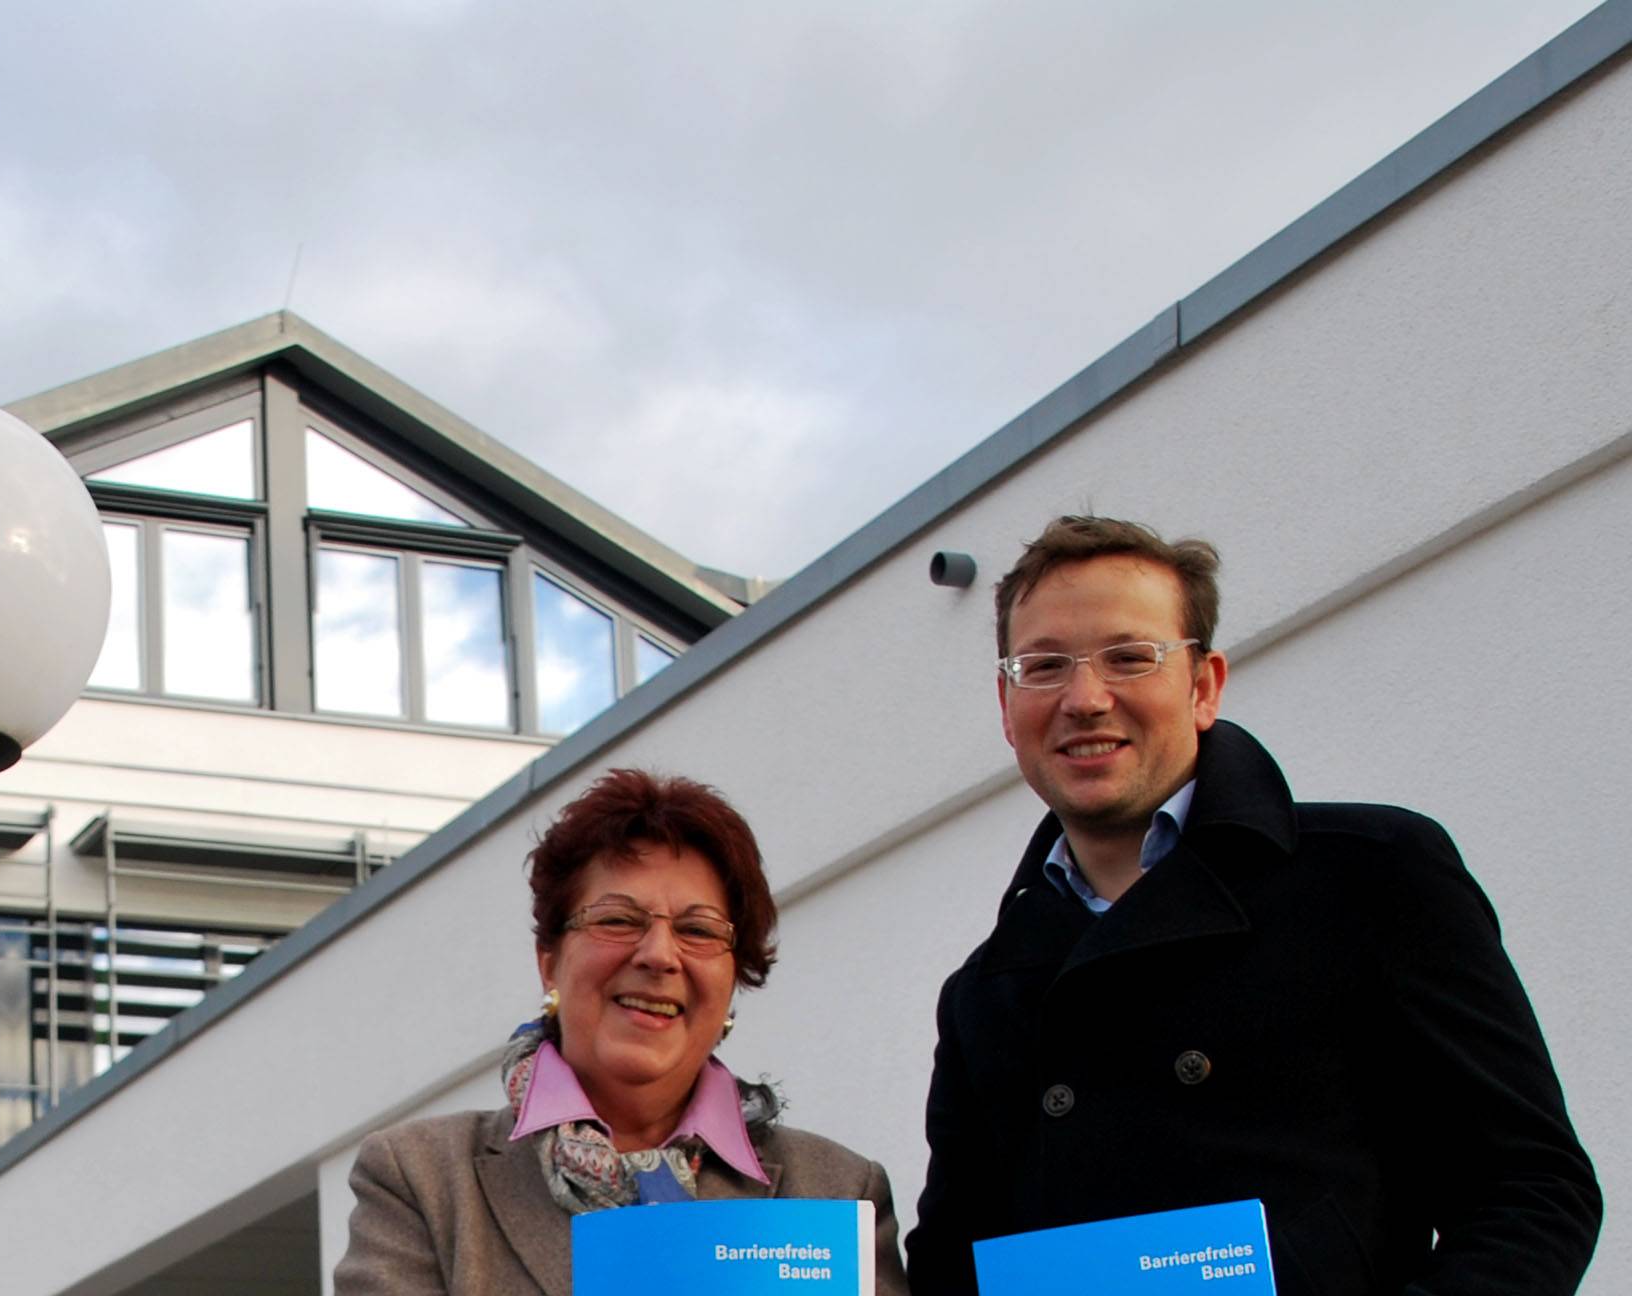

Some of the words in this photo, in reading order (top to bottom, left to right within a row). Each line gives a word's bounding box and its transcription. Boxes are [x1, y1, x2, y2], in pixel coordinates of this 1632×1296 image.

[715, 1244, 831, 1260] Barrierefreies
[1139, 1243, 1254, 1270] Barrierefreies
[779, 1263, 831, 1280] Bauen
[1201, 1263, 1256, 1280] Bauen
